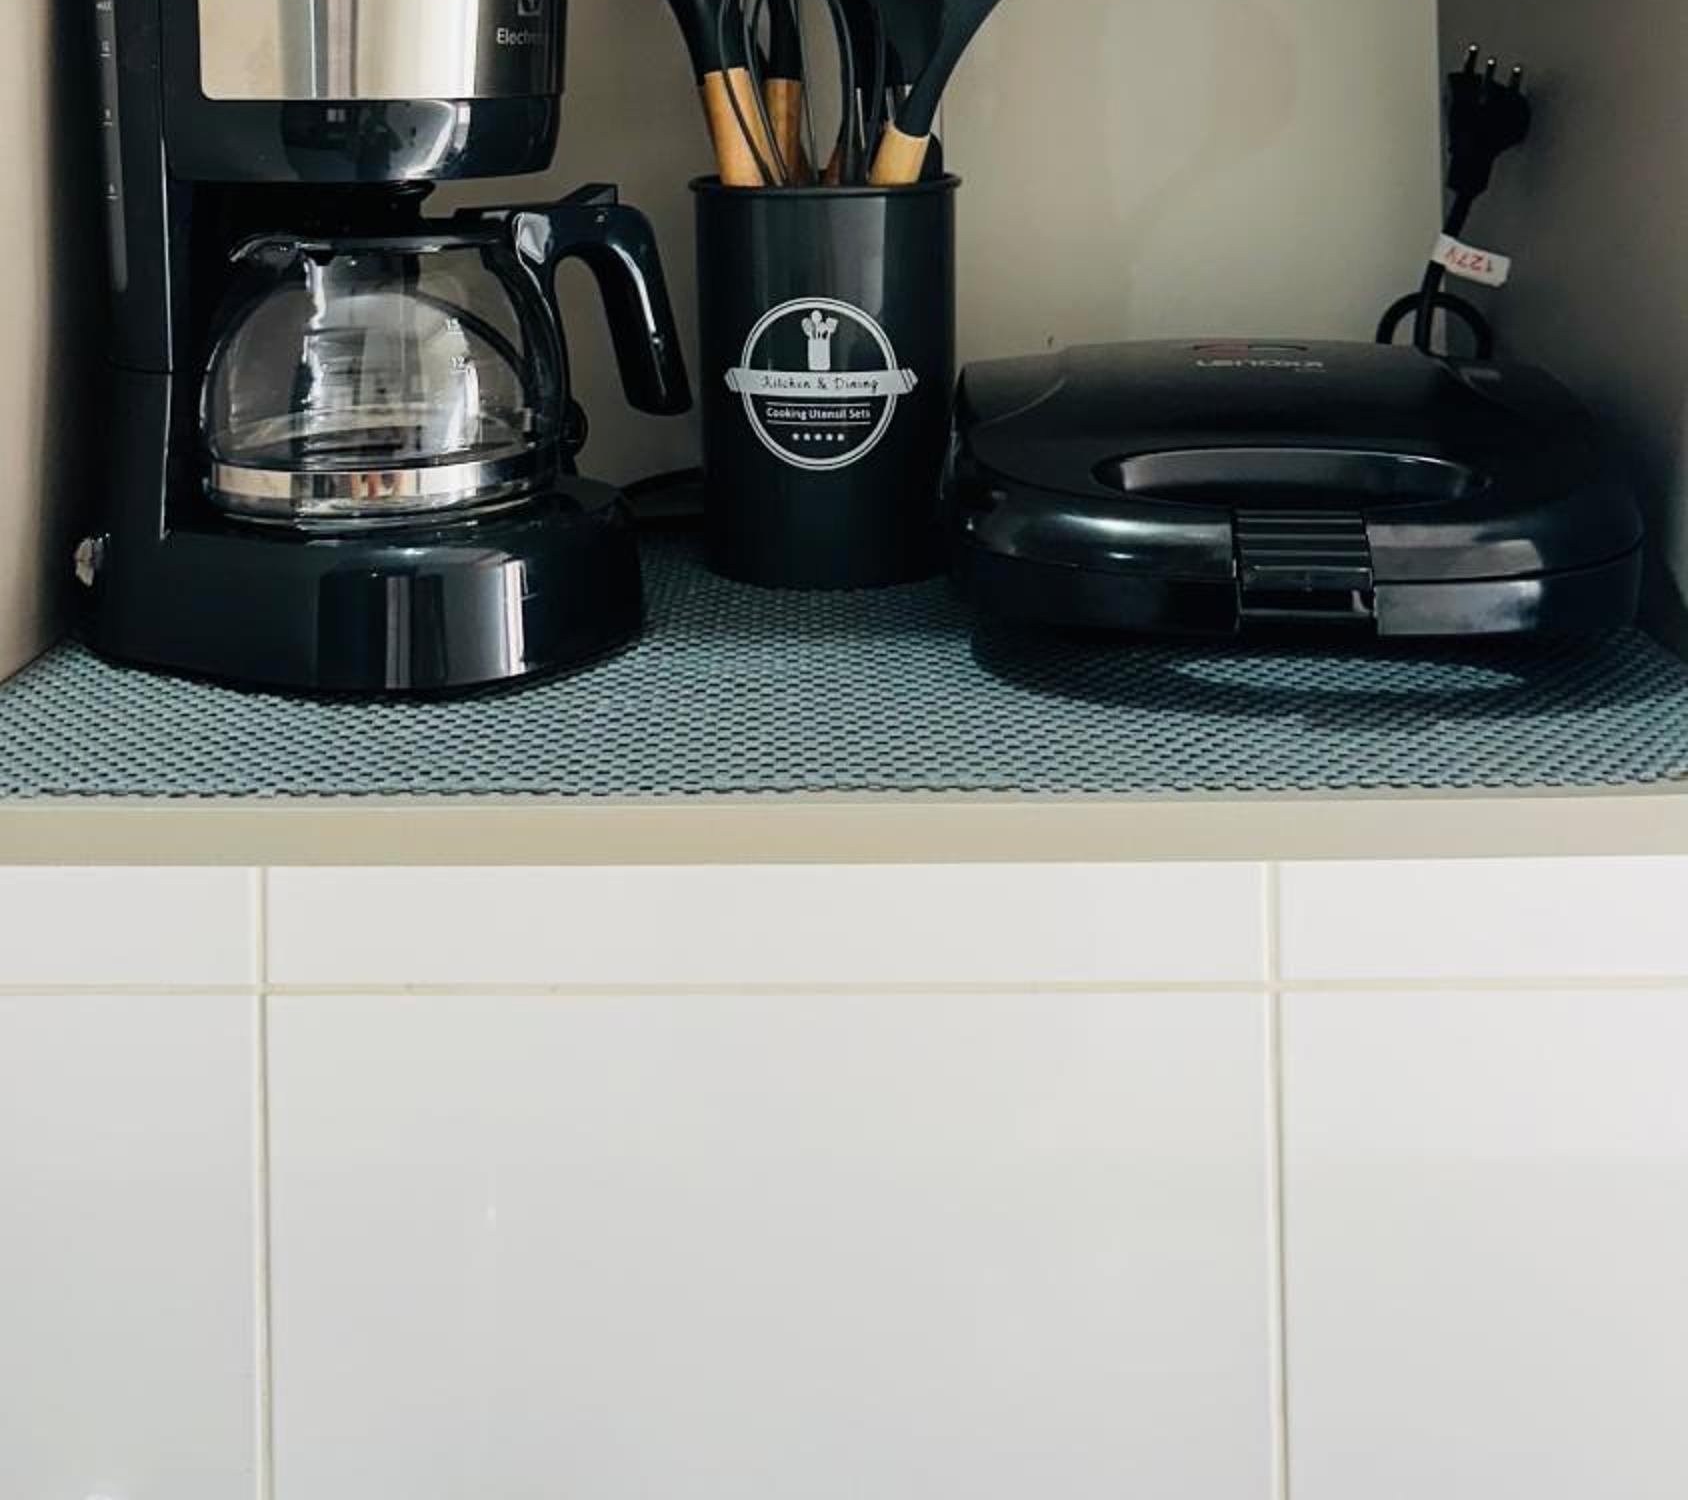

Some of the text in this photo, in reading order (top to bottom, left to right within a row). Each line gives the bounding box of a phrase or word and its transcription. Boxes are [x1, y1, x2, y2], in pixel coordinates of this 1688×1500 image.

[762, 375, 879, 394] Kitchen & Dining
[766, 407, 871, 421] Cooking Utensil Sets
